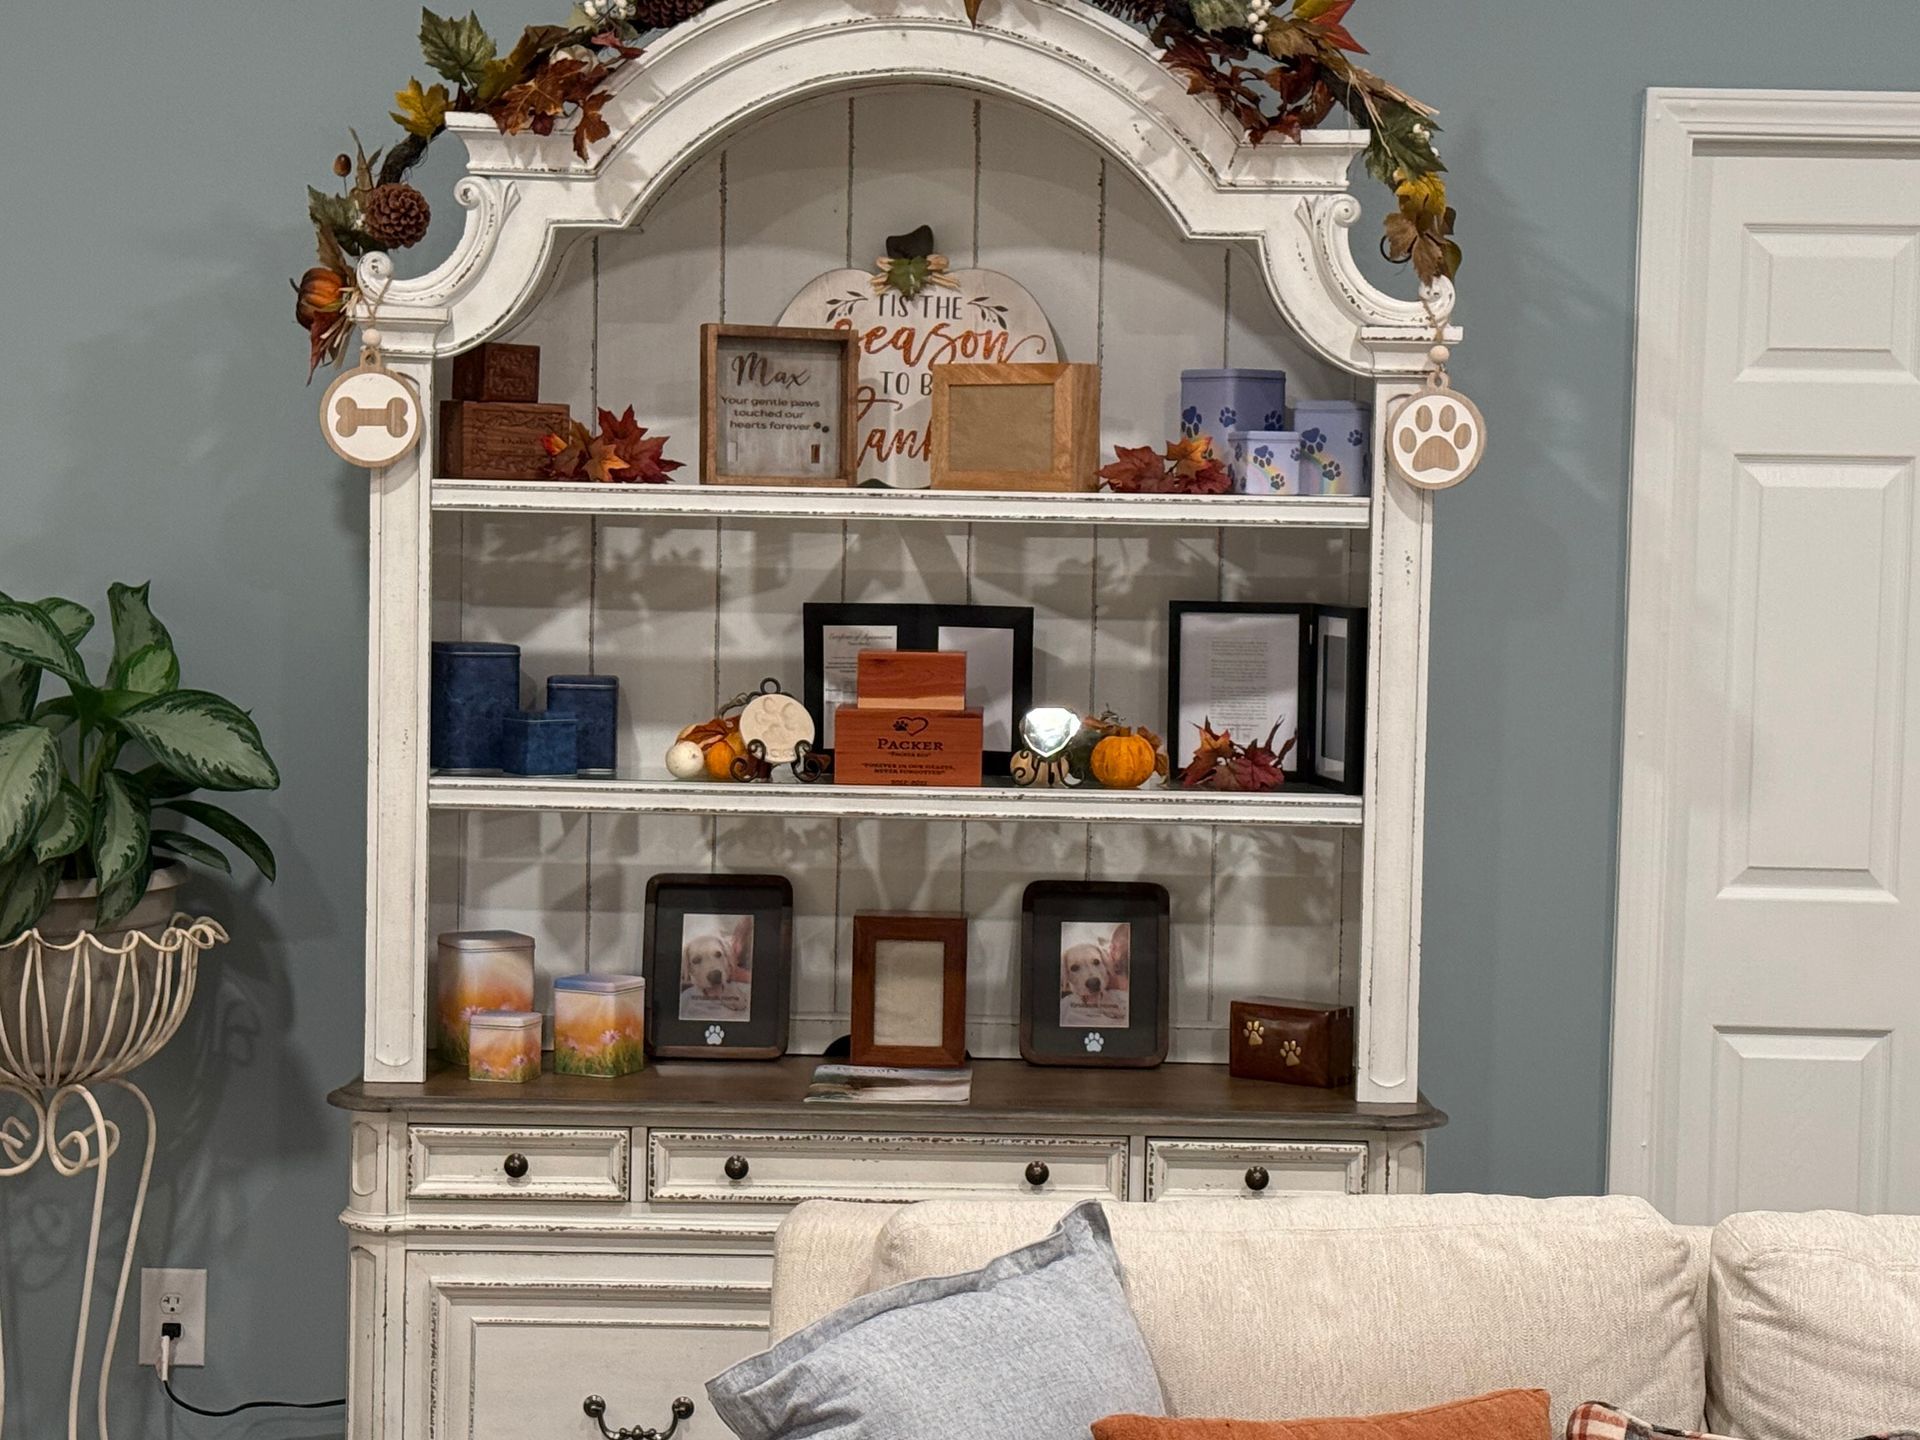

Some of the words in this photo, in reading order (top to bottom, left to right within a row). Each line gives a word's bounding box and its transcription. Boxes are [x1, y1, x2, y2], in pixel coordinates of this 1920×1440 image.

[878, 293, 909, 318] TIS
[919, 294, 964, 320] THE
[835, 318, 1047, 371] eason
[731, 351, 811, 389] Max
[879, 371, 910, 395] TO
[721, 396, 749, 405] Your
[751, 397, 788, 407] gentle
[791, 399, 820, 408] paws
[734, 409, 782, 418] touched
[784, 411, 805, 419] our
[729, 420, 767, 430] hearts
[769, 421, 811, 431] forever
[877, 738, 944, 752] PACKER
